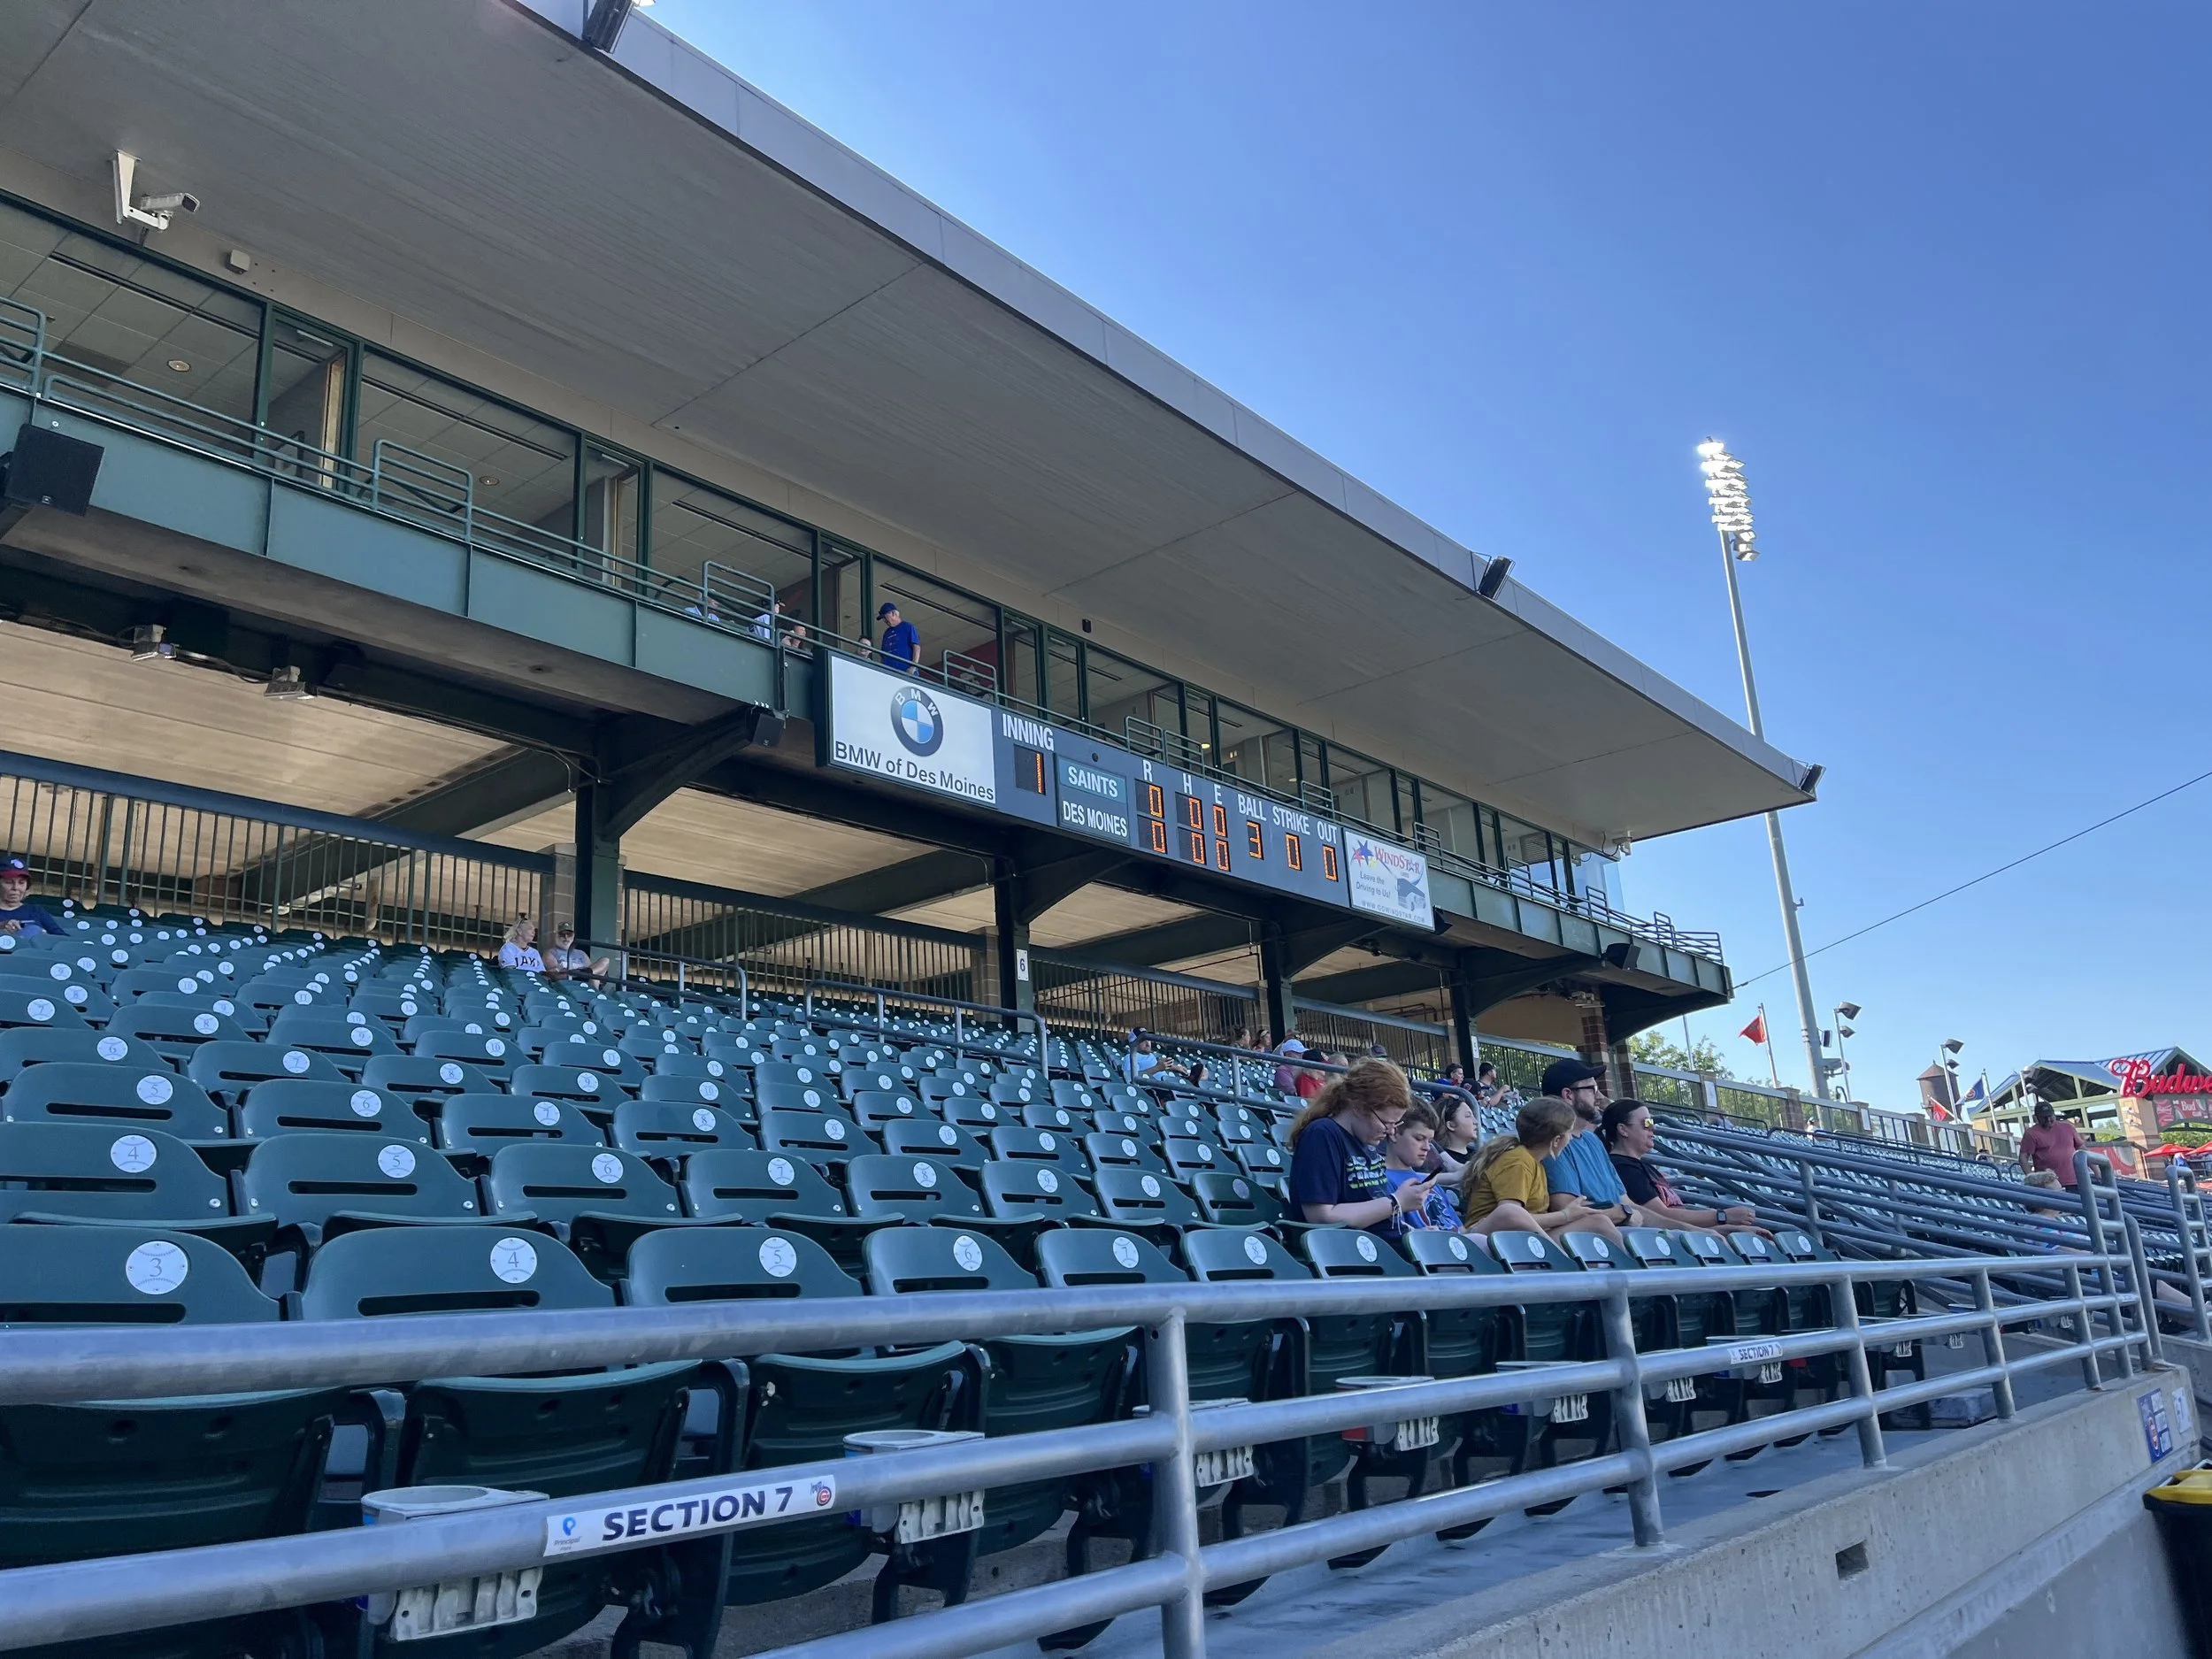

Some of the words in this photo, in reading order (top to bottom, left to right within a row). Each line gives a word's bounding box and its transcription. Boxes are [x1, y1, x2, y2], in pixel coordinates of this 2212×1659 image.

[895, 688, 939, 717] BMW
[1002, 713, 1055, 752] INNING
[835, 741, 880, 769] BMW
[886, 758, 902, 775] of
[907, 760, 936, 785] Des
[940, 771, 995, 801] Moines
[1068, 765, 1118, 798] SAINTS
[1142, 759, 1153, 782] R
[1183, 772, 1194, 795] H
[1213, 783, 1223, 806] E
[1063, 801, 1085, 826] DES
[1087, 806, 1128, 838] MOINES
[1149, 785, 1164, 818] 0
[1188, 797, 1202, 830] 0
[1213, 804, 1227, 837] 0
[1237, 794, 1267, 822] BALL
[1273, 805, 1310, 836] STRIKE
[1246, 821, 1263, 860] 3
[1317, 822, 1338, 844] OUT
[1152, 820, 1166, 854] 0
[1191, 832, 1205, 864] 0
[1216, 840, 1230, 872] 0
[1286, 833, 1302, 871] 0
[1323, 844, 1338, 882] 0
[1360, 871, 1376, 882] Leave
[1356, 881, 1375, 895] Driving
[1376, 887, 1382, 896] to
[1382, 888, 1391, 898] Us!
[1019, 958, 1025, 972] 6
[151, 1085, 158, 1094] 5
[363, 1099, 370, 1110] 6
[128, 1147, 139, 1160] 4
[393, 1156, 401, 1167] 5
[604, 1163, 611, 1174] 6
[507, 1251, 519, 1267] 4
[774, 1250, 782, 1264] 5
[964, 1248, 972, 1261] 6
[149, 1257, 163, 1277] 3
[1739, 1346, 1769, 1361] SECTION
[1769, 1345, 1774, 1356] 7
[603, 1490, 765, 1541] SECTION
[775, 1486, 793, 1512] 7
[554, 1536, 580, 1547] Principal
